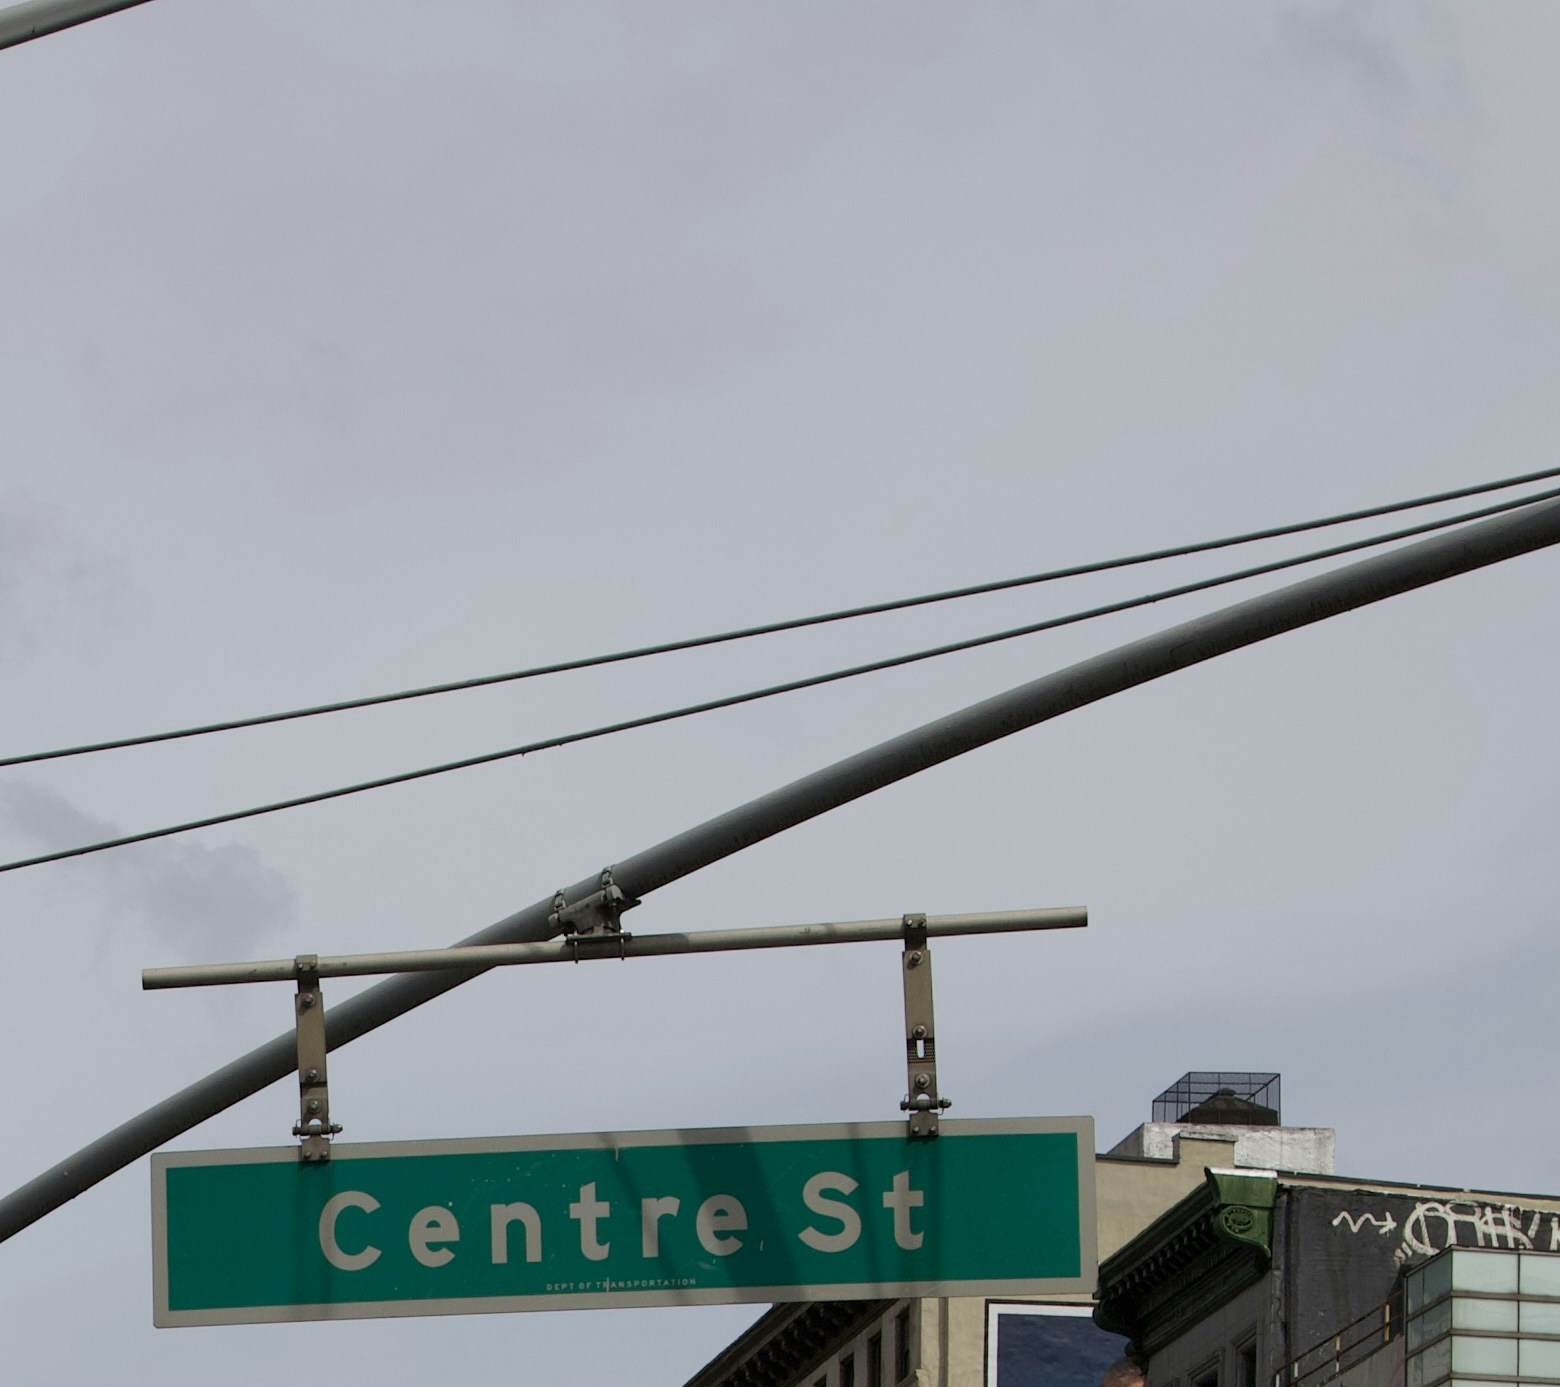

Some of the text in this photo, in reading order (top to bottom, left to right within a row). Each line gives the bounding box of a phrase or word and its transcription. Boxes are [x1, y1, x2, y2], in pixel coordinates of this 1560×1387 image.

[319, 1170, 925, 1272] Centre St
[546, 1277, 697, 1291] DEPT OF TRANSPORTATION
